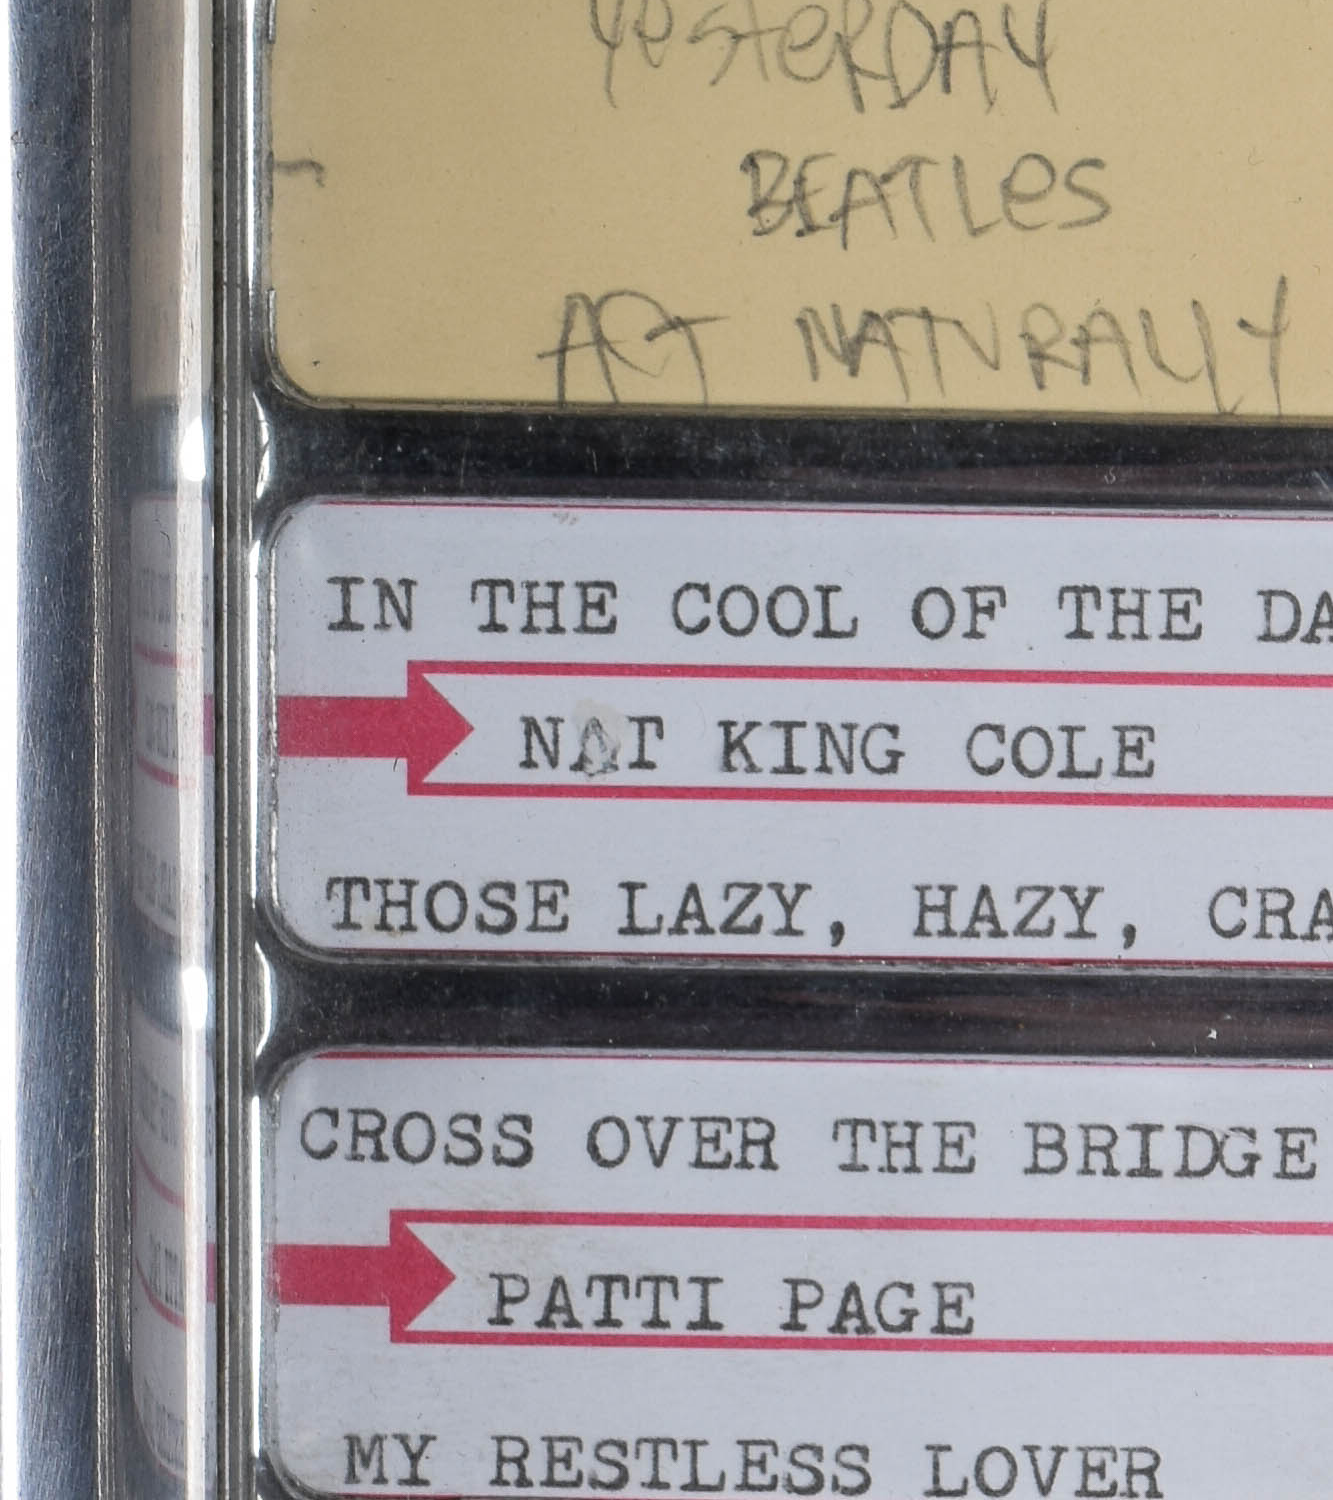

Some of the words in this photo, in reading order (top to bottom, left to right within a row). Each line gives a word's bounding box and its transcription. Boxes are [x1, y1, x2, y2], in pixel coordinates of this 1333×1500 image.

[327, 576, 418, 632] IN
[470, 578, 617, 635] THE
[671, 582, 858, 639] COOL
[911, 585, 1007, 641] OF
[1057, 584, 1203, 642] THE
[517, 702, 668, 778] NAT
[717, 720, 905, 776] KING
[965, 723, 1155, 780] COLE
[326, 876, 569, 936] THOSE
[617, 881, 845, 948] LAZY,
[912, 884, 1137, 950] HAZY,
[300, 1106, 534, 1168] CROSS
[586, 1115, 779, 1172] OVER
[832, 1118, 976, 1174] THE
[1023, 1122, 1317, 1180] BRIDGE
[487, 1272, 724, 1331] PATTI
[779, 1278, 975, 1336] PAGE
[343, 1433, 437, 1487] MY
[489, 1435, 872, 1497] RESTLESS
[923, 1444, 1164, 1499] LOVER
